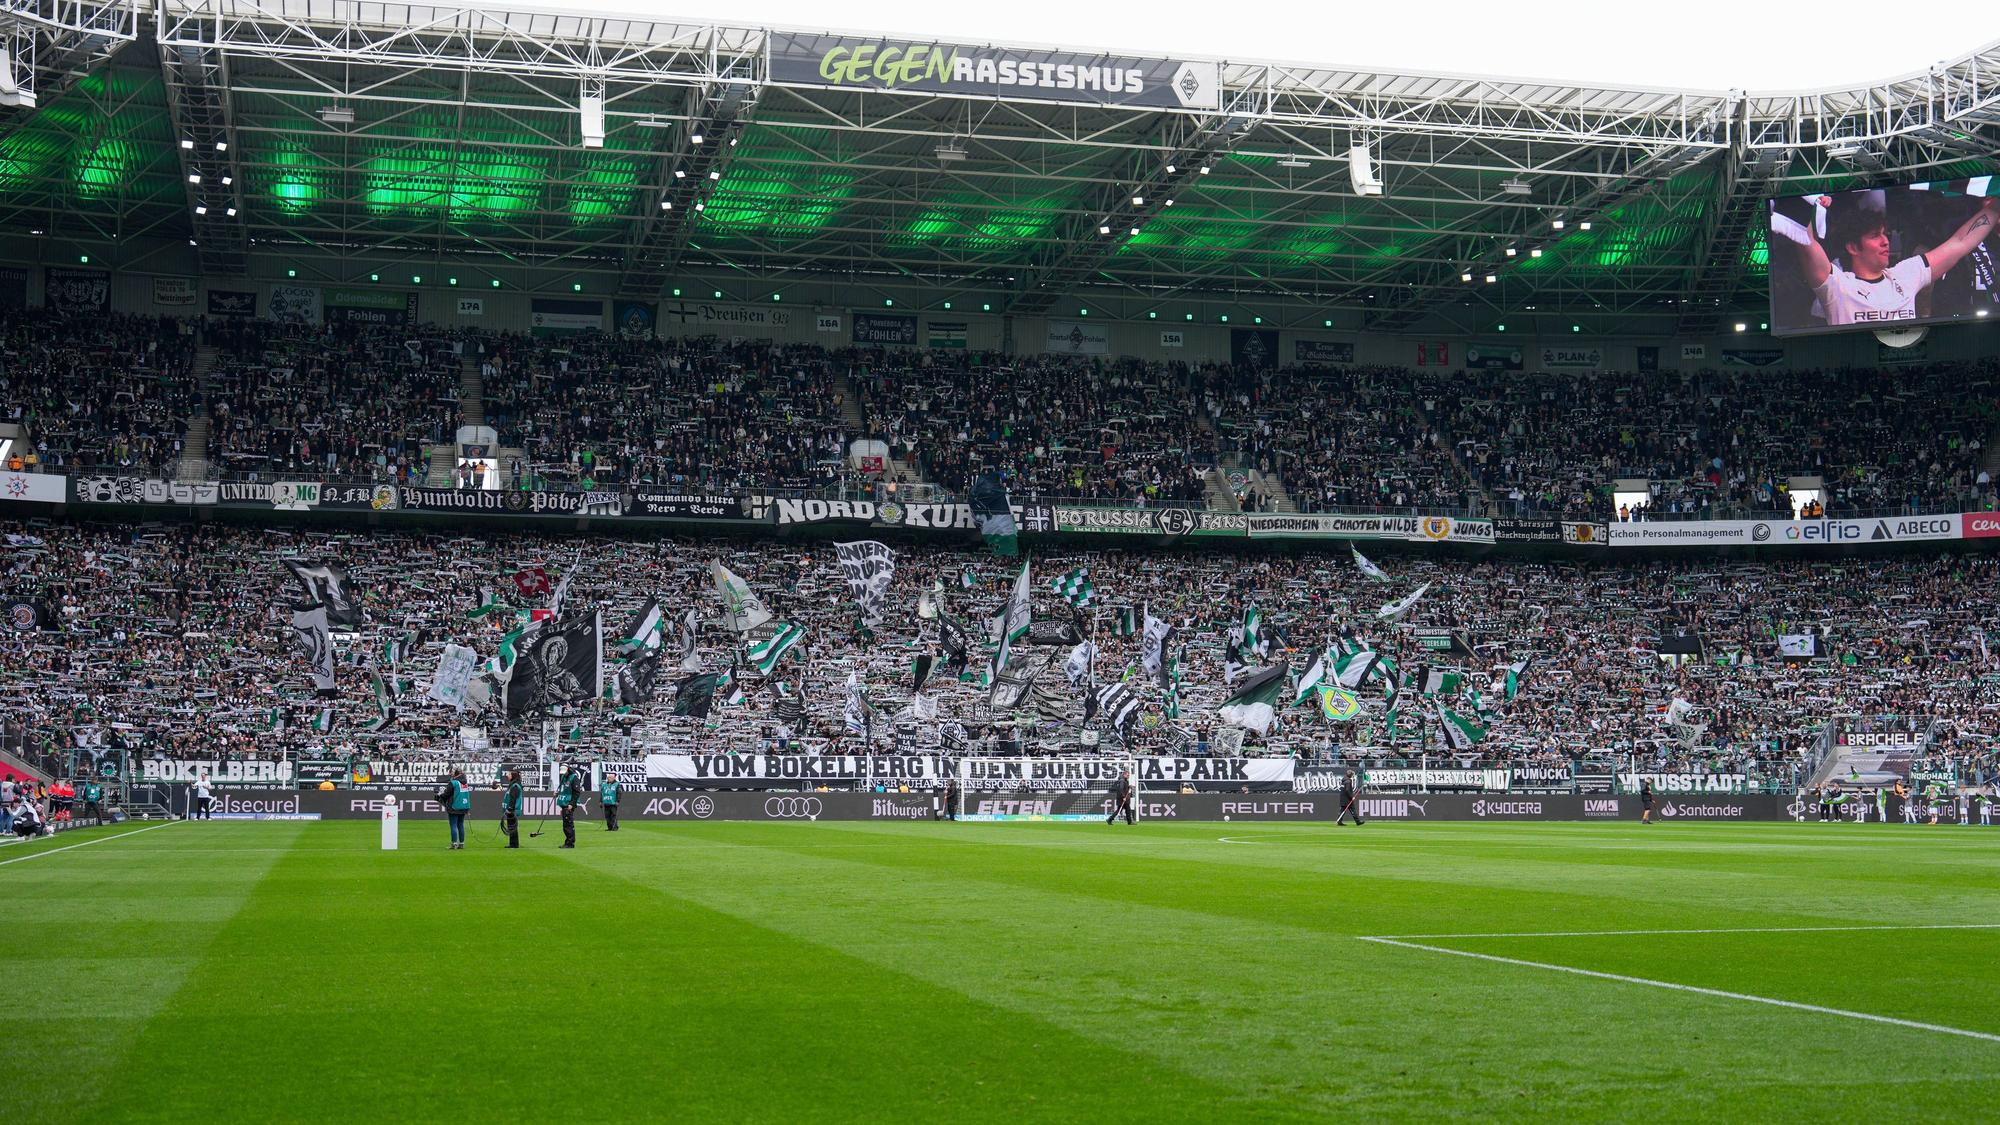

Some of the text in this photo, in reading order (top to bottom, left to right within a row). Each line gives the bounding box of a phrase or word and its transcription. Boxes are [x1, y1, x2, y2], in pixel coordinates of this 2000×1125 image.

[819, 45, 1144, 93] GEGEN RASSISMUS
[347, 310, 386, 322] Fohlen
[1854, 309, 1915, 321] REUTER
[819, 319, 838, 328] 16A
[869, 330, 902, 341] FOHLEN
[1163, 335, 1181, 343] 15A
[1558, 352, 1586, 362] PLAN
[220, 484, 274, 500] UNITED
[296, 485, 317, 501] MG
[637, 493, 735, 505] Commando Ultra
[401, 487, 585, 513] Humboldt Pöbel
[647, 504, 676, 513] Nero
[690, 505, 725, 515] Verde
[776, 499, 1024, 530] NORD KURE
[1057, 509, 1152, 528] BORUSSIA
[1199, 512, 1248, 530] FANS
[1896, 519, 1951, 535] ABECO
[1250, 519, 1492, 536] NIEDERRHEIN CHAOTEN WILDE JUNGS
[1609, 528, 1744, 540] Cichon Personalmanagement
[1803, 521, 1861, 542] elfio
[368, 761, 449, 776] WILLICHER
[692, 756, 756, 778] VOM
[765, 756, 924, 779] BOKELBERG
[970, 758, 1022, 779] DEN
[1032, 758, 1249, 780] BORUSIA-PARK
[1513, 768, 1571, 781] PUMUCKL
[1911, 771, 1954, 780] NORDHARZ
[385, 775, 437, 784] FOHLEN
[985, 779, 1087, 791] SPONSRENNAMEN!
[1426, 769, 1482, 786] SERVICE
[215, 795, 300, 814] e[secure]
[351, 799, 447, 812] RETE
[643, 797, 690, 815] AOK
[872, 798, 929, 819] Bitburger
[977, 800, 1053, 815] ELTEN
[1101, 798, 1177, 818] fltex
[1222, 802, 1314, 814] REUTER
[1358, 799, 1408, 817] PUMA
[1487, 801, 1542, 814] KYOCERA
[1584, 799, 1609, 811] LVM
[1679, 803, 1744, 818] Santander
